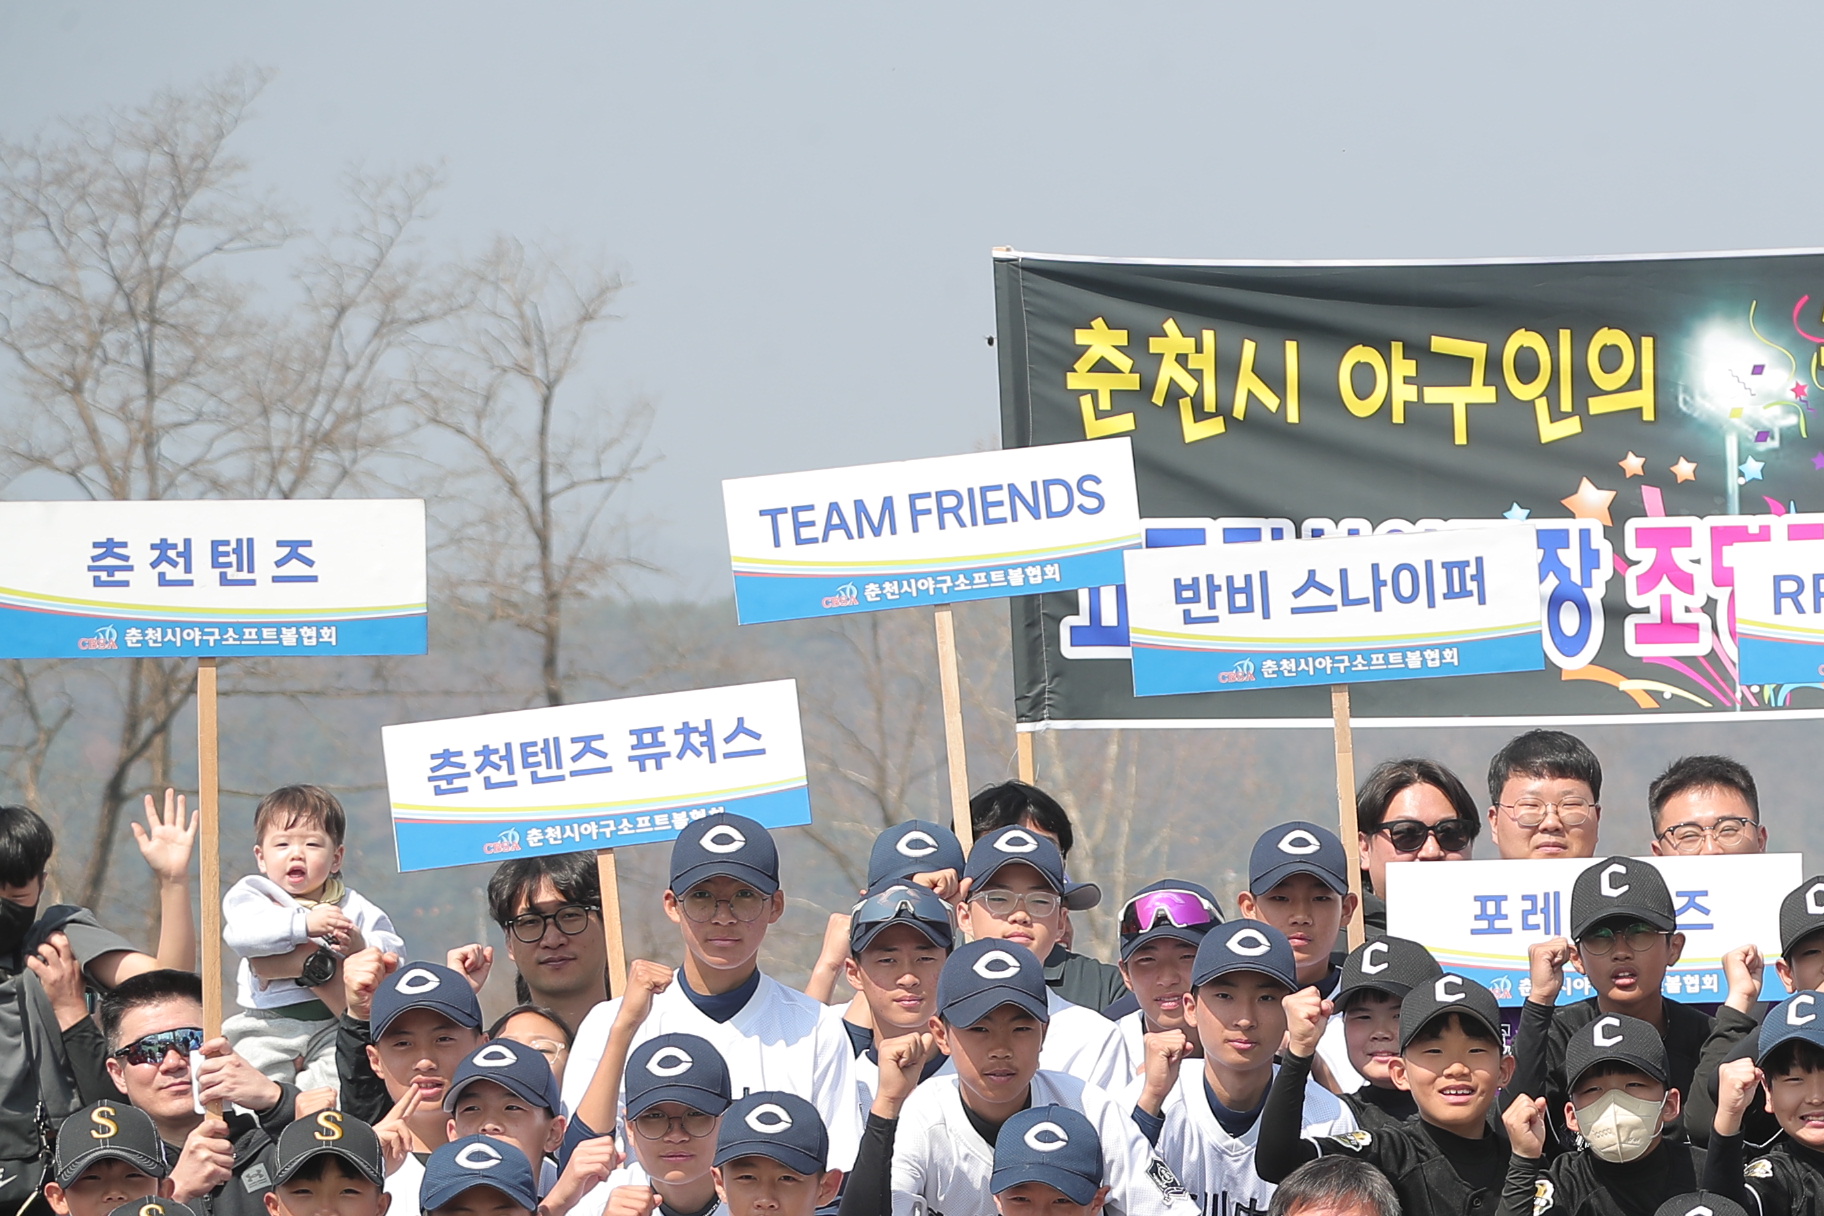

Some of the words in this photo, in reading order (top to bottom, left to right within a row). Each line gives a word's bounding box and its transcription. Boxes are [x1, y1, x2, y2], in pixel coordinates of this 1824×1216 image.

[1066, 315, 1299, 444] 춘천시
[1337, 326, 1657, 446] 야구인의
[759, 496, 897, 548] TEAM
[908, 474, 1105, 533] FRIENDS
[864, 563, 1061, 602] 춘천시야구소프트볼협회
[1174, 569, 1271, 625] 반비
[1291, 556, 1486, 615] 스나이퍼
[124, 623, 338, 648] 춘천시야구소프트볼협회
[1261, 648, 1459, 678] 춘천시야구소프트볼협회
[427, 733, 614, 797] 춘천텐즈
[628, 714, 767, 773] 퓨쳐스
[90, 1107, 118, 1139] S
[314, 1110, 343, 1140] S
